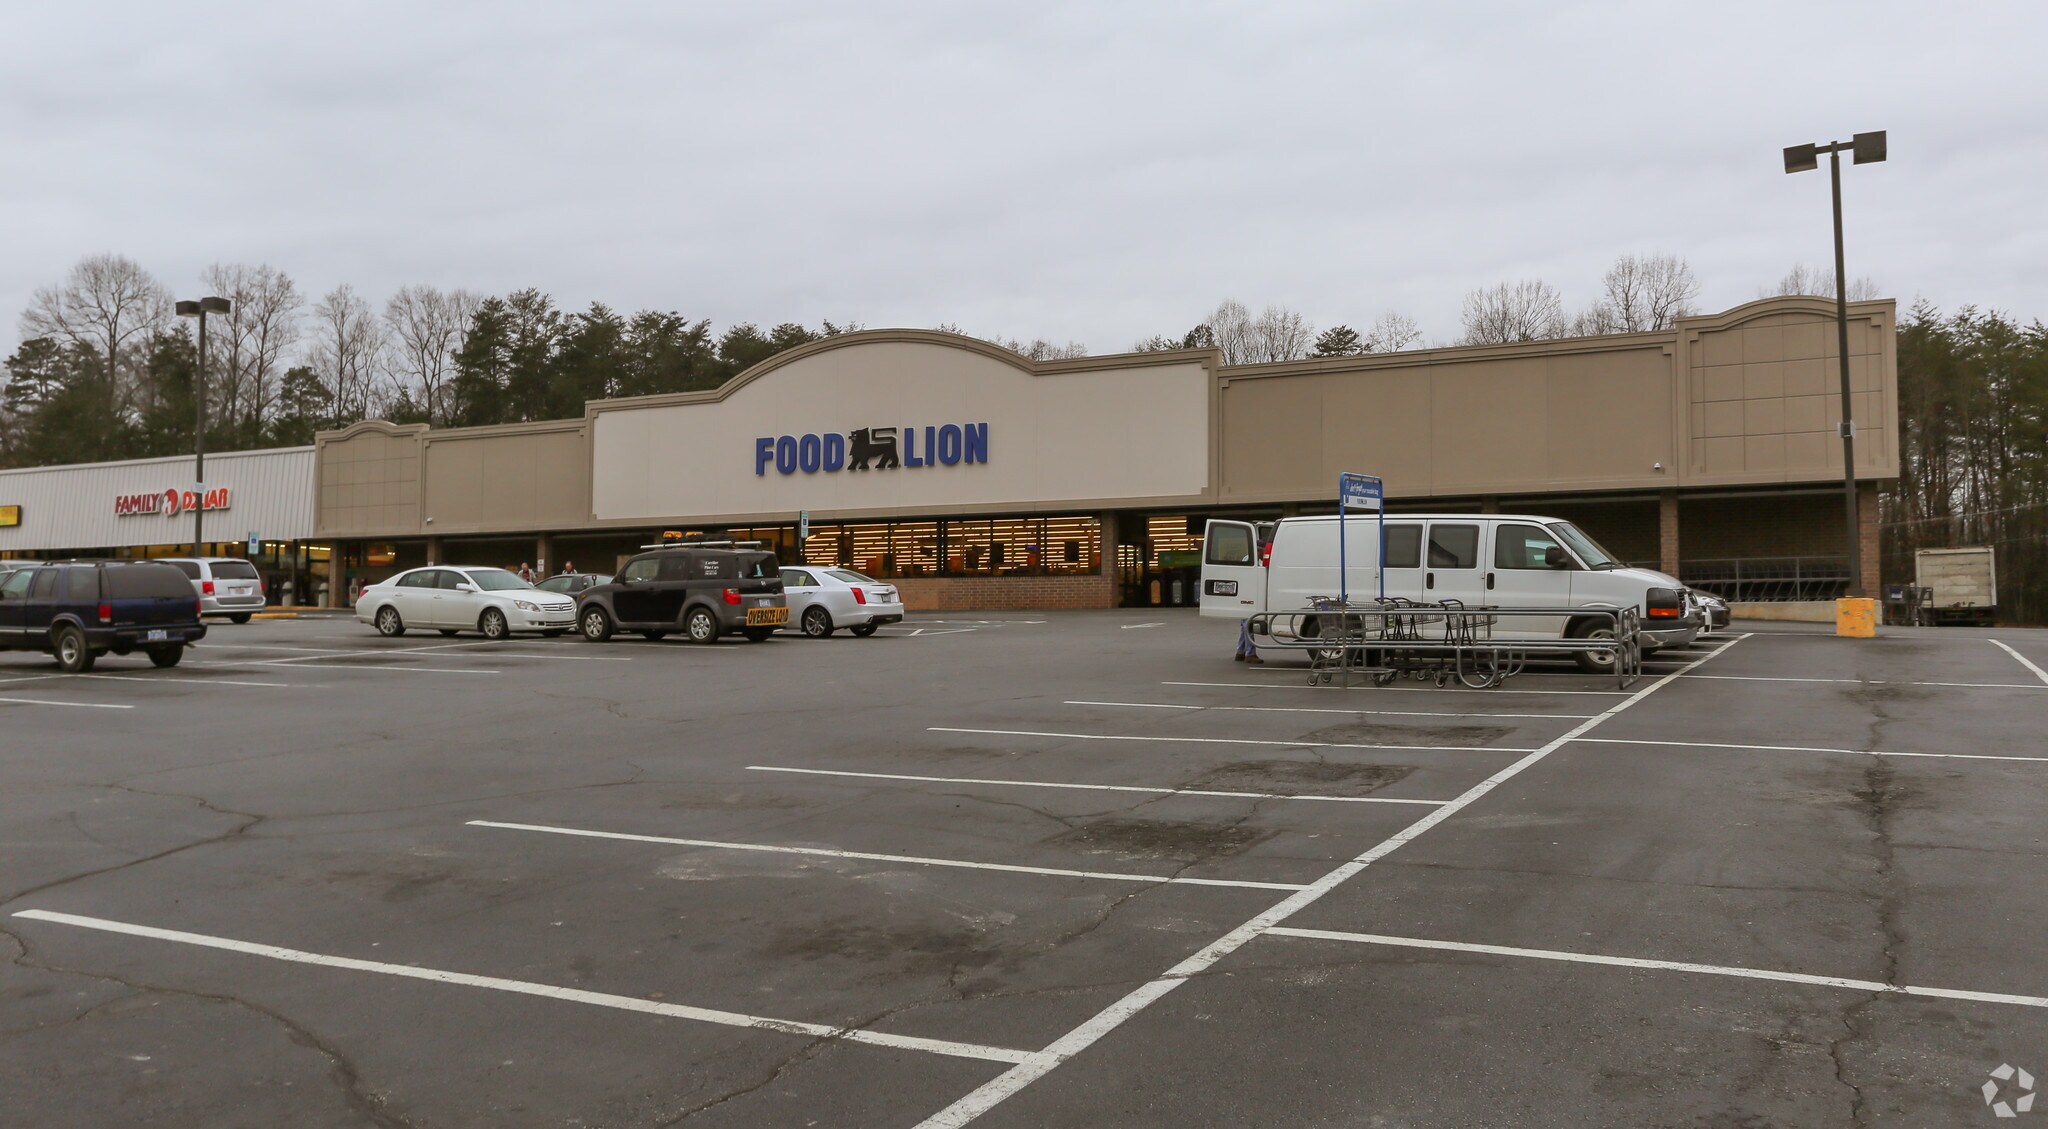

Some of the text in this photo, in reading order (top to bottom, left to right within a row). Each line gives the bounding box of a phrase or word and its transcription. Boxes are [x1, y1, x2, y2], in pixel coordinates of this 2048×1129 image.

[755, 422, 989, 476] FOOD LION
[115, 493, 160, 514] FAMILY
[182, 487, 229, 511] DLAR
[748, 609, 775, 624] OVERSIZE
